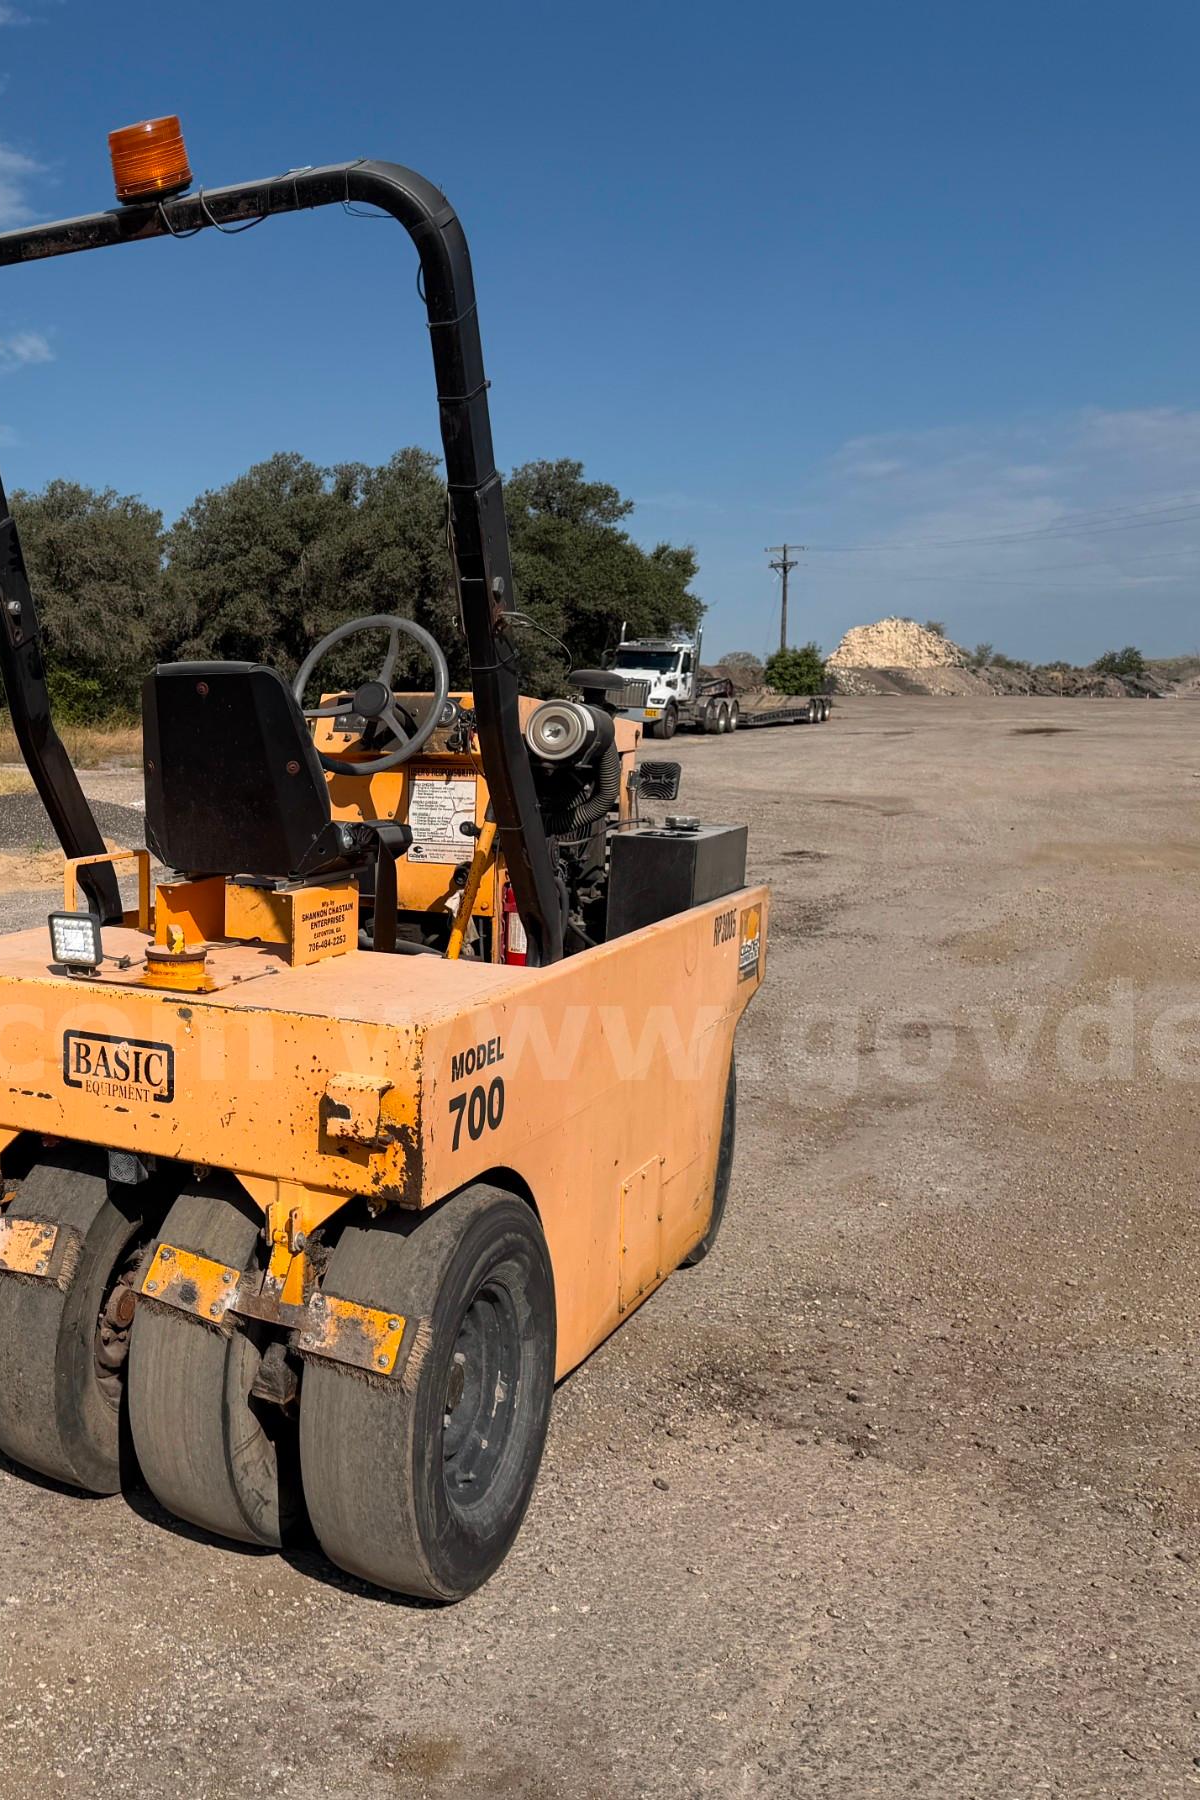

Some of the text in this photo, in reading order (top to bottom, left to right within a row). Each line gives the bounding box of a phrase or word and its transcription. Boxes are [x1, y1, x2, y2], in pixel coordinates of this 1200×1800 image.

[302, 902, 353, 922] SHANNON CHASTAIN
[311, 914, 345, 930] ENTERPRISES
[73, 1041, 163, 1087] BASIC
[450, 1036, 505, 1083] MODEL
[85, 1079, 150, 1103] EQUIPMENT
[448, 1075, 506, 1152] 700
